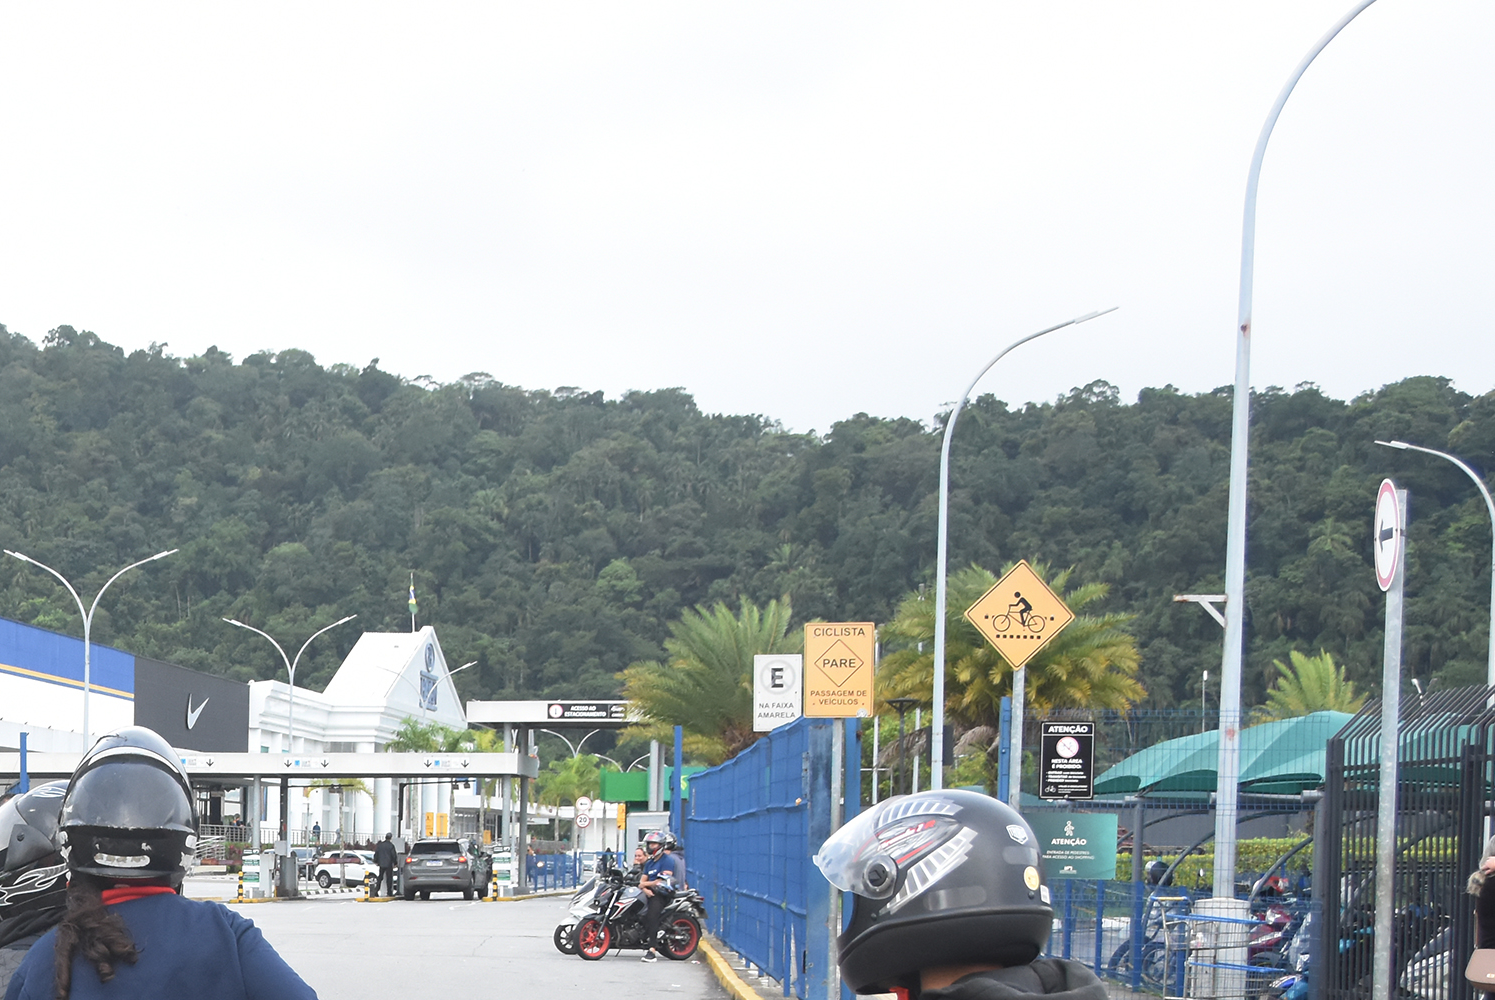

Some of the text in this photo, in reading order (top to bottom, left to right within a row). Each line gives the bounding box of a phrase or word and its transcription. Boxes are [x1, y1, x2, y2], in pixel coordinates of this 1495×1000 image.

[813, 627, 865, 637] CICLISTA
[822, 658, 856, 668] PARE
[771, 668, 784, 688] E
[1048, 725, 1088, 734] ATENÇÃO
[1051, 837, 1087, 846] ATENÇÃO
